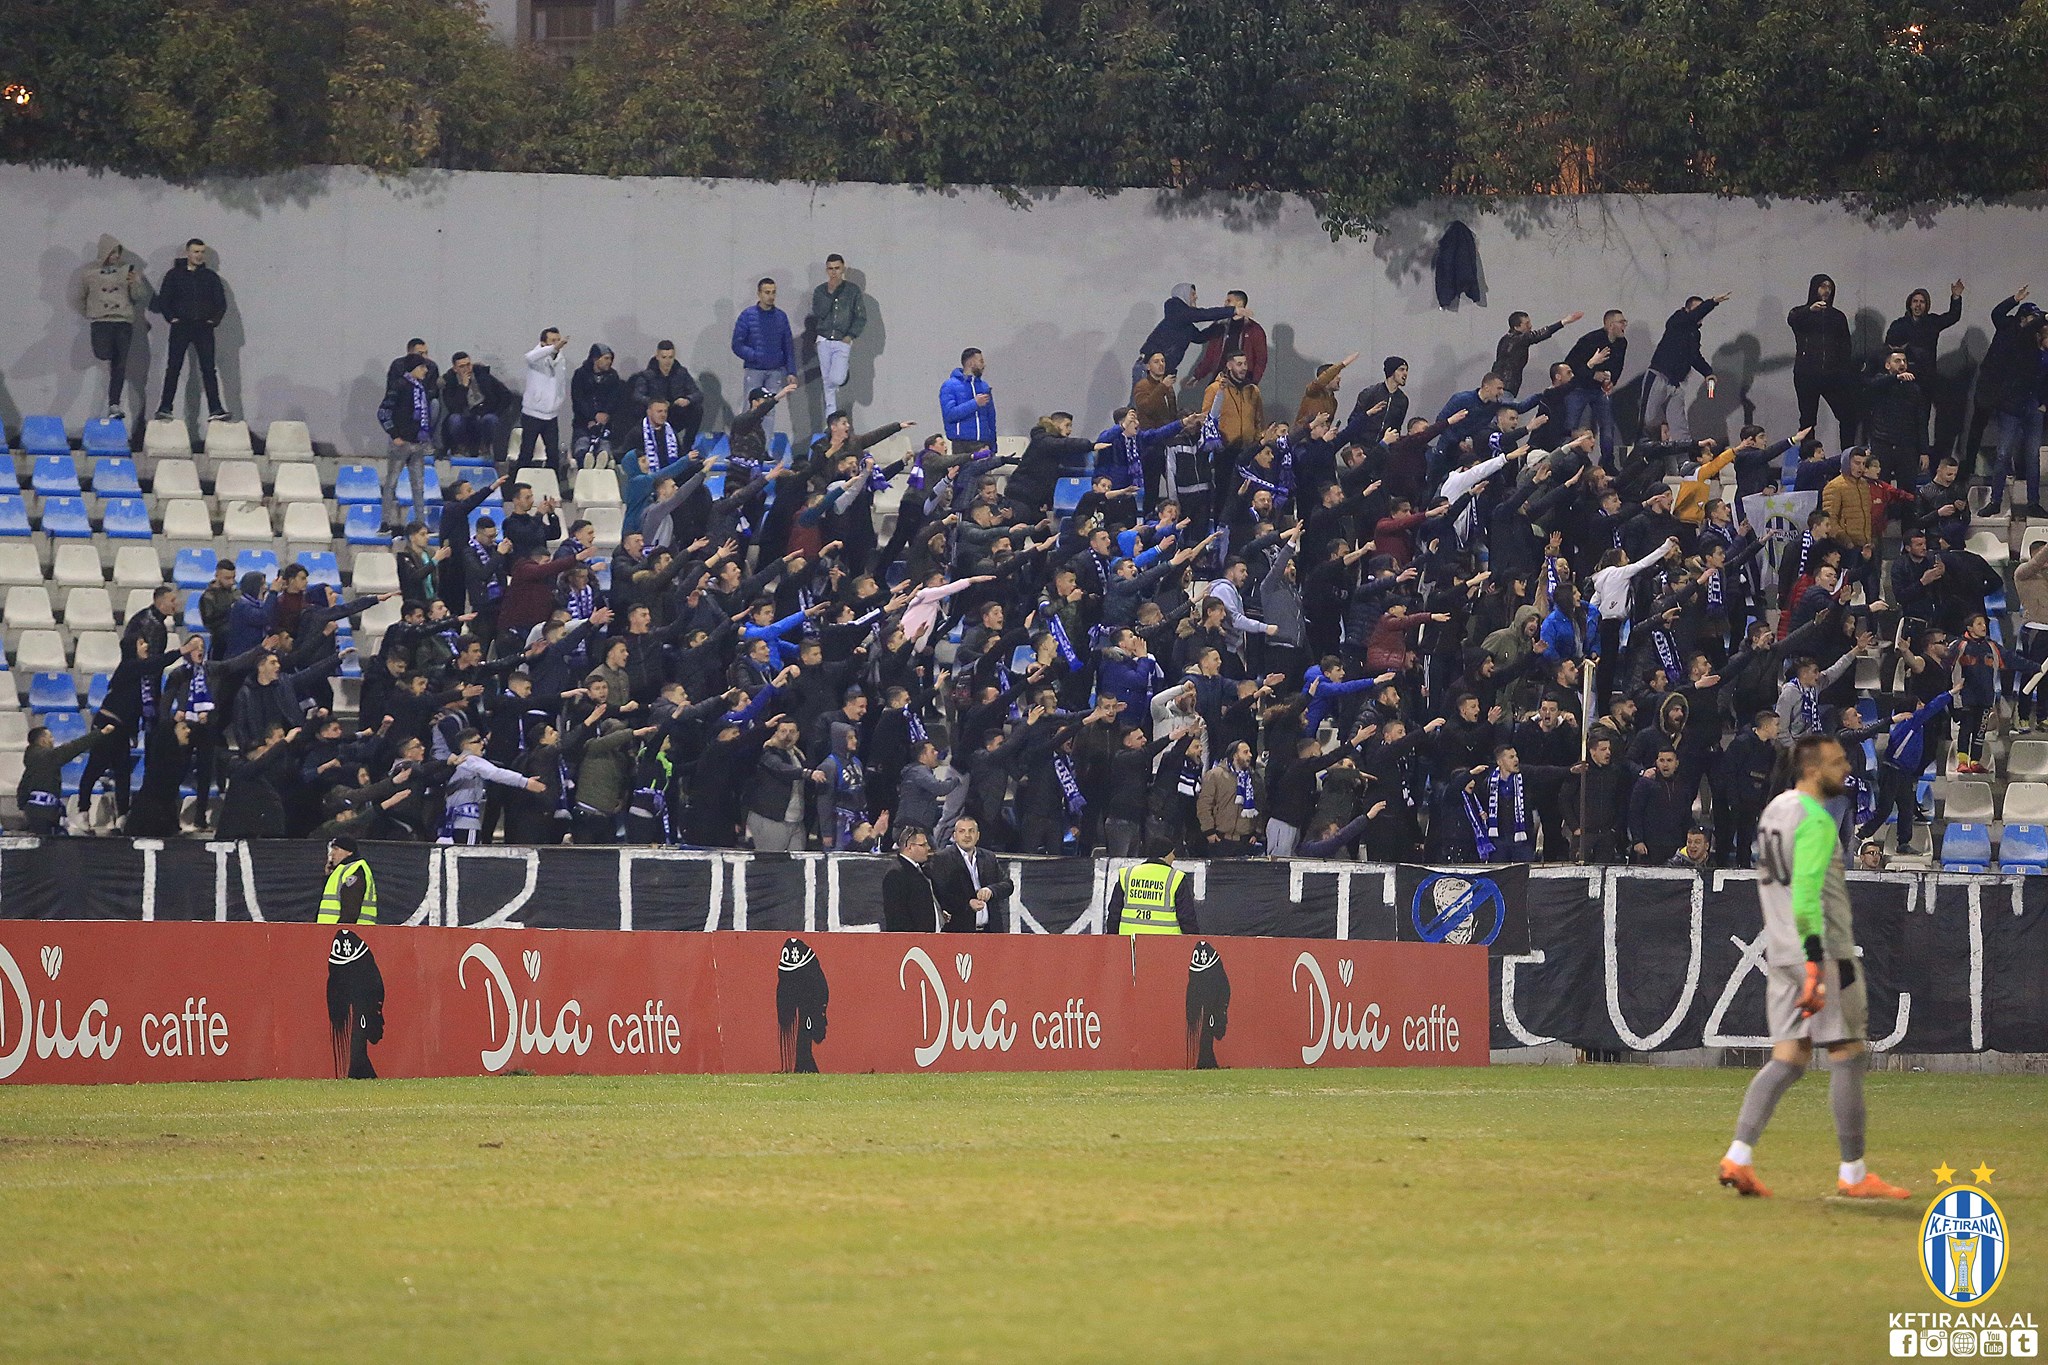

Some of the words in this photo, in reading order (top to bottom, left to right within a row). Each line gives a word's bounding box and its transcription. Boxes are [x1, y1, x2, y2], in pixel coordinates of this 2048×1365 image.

[1129, 889, 1164, 902] SECURITY
[1130, 878, 1164, 891] OKTAPUS
[1136, 909, 1152, 920] 218
[141, 997, 228, 1057] caffe
[459, 943, 592, 1071] Dua
[608, 1000, 681, 1054] caffe
[900, 947, 1017, 1067] Dua
[1032, 998, 1101, 1049] caffe
[1293, 952, 1390, 1064] Dua
[1403, 1004, 1459, 1052] caffe
